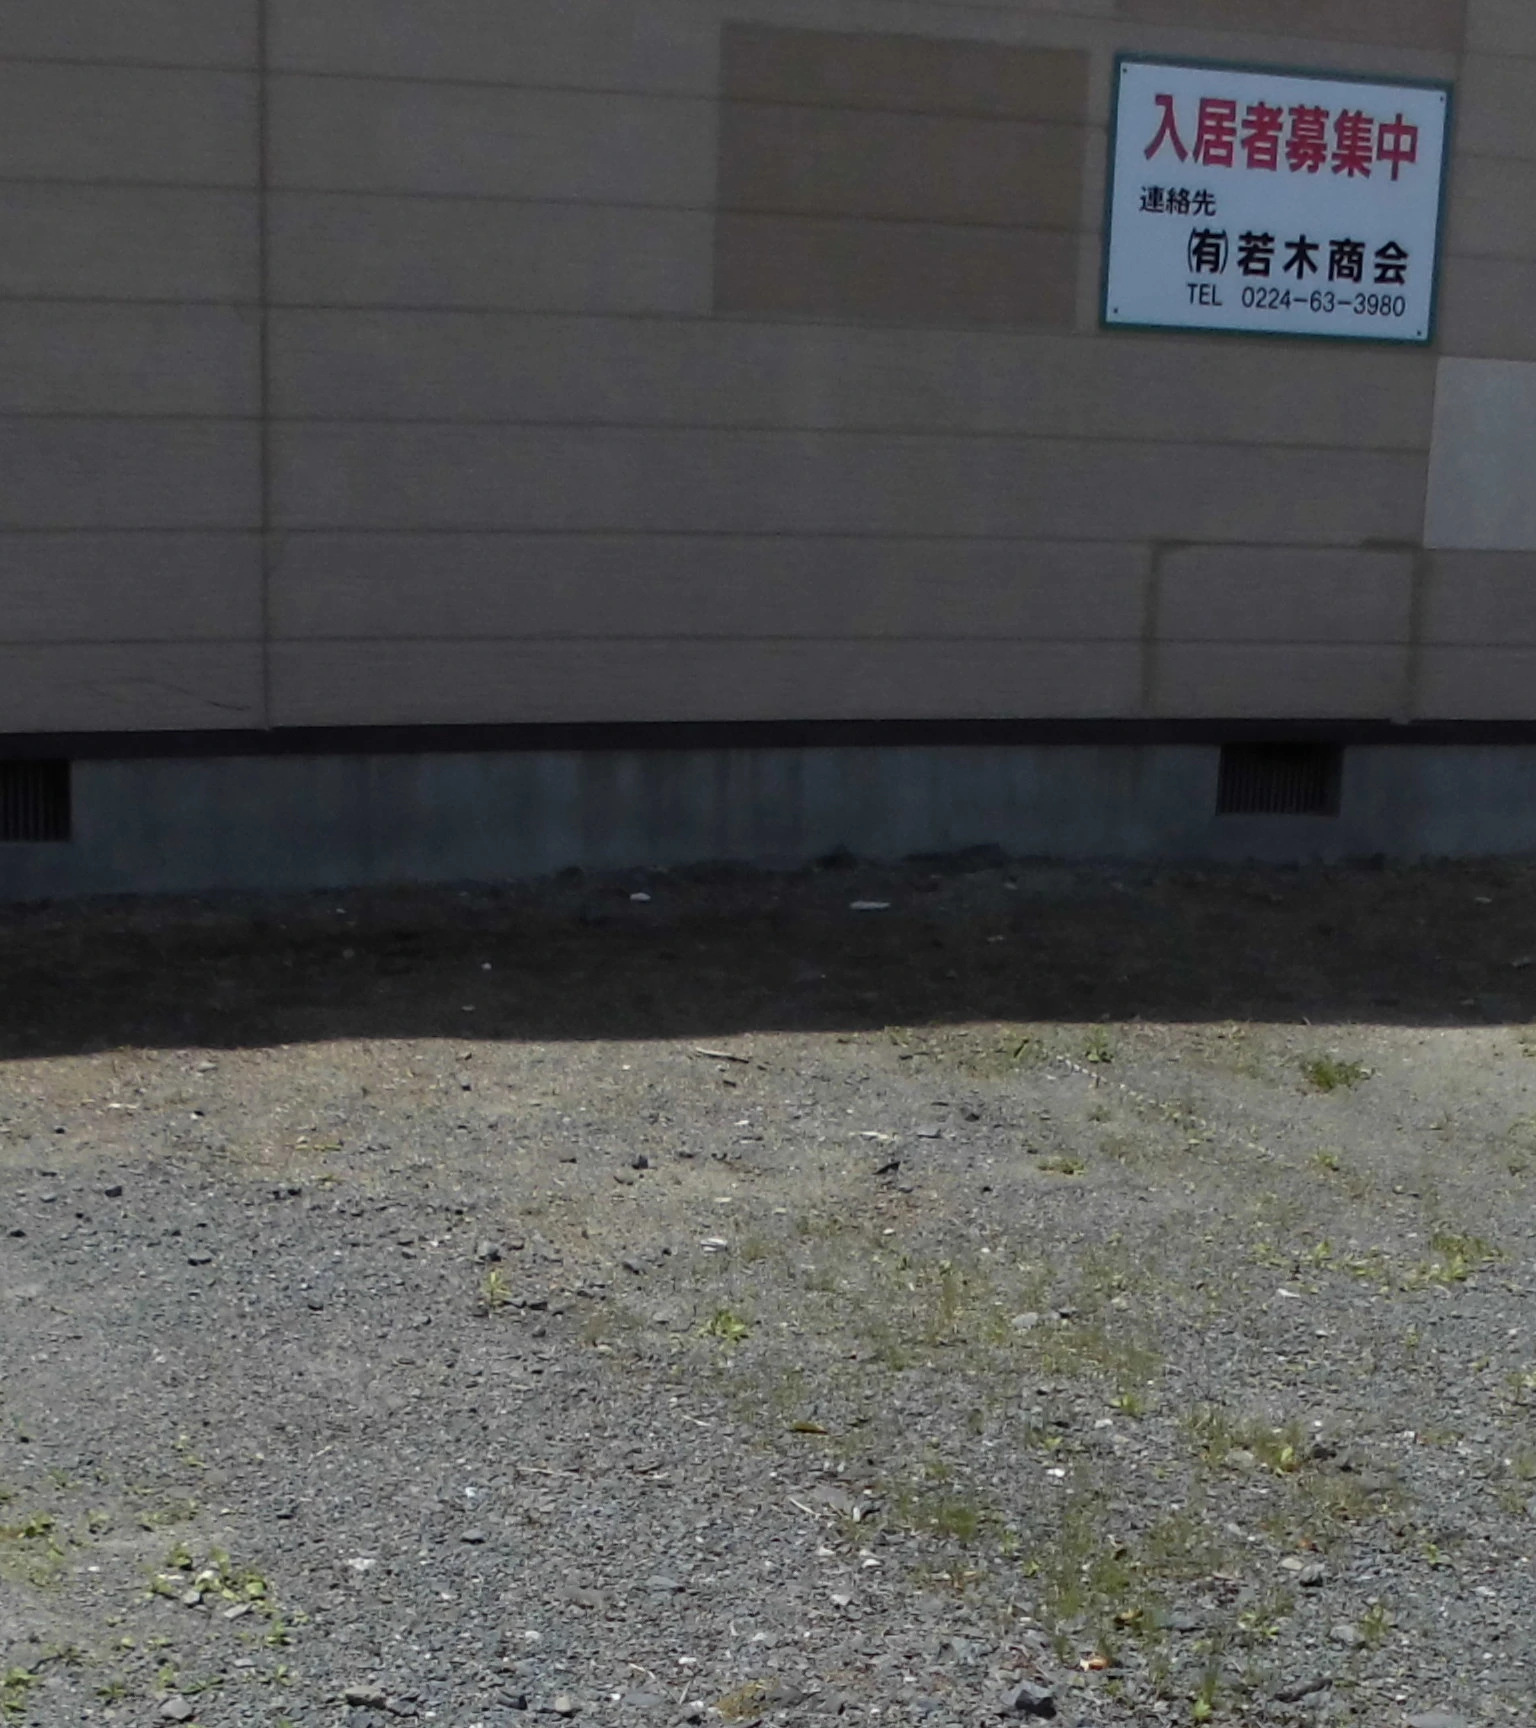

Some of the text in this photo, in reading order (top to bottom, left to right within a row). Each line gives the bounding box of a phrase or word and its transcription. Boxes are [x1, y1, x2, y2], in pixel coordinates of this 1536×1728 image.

[1143, 92, 1418, 182] 入居者募集中
[1138, 185, 1217, 217] 連絡先
[1187, 283, 1223, 307] TEL
